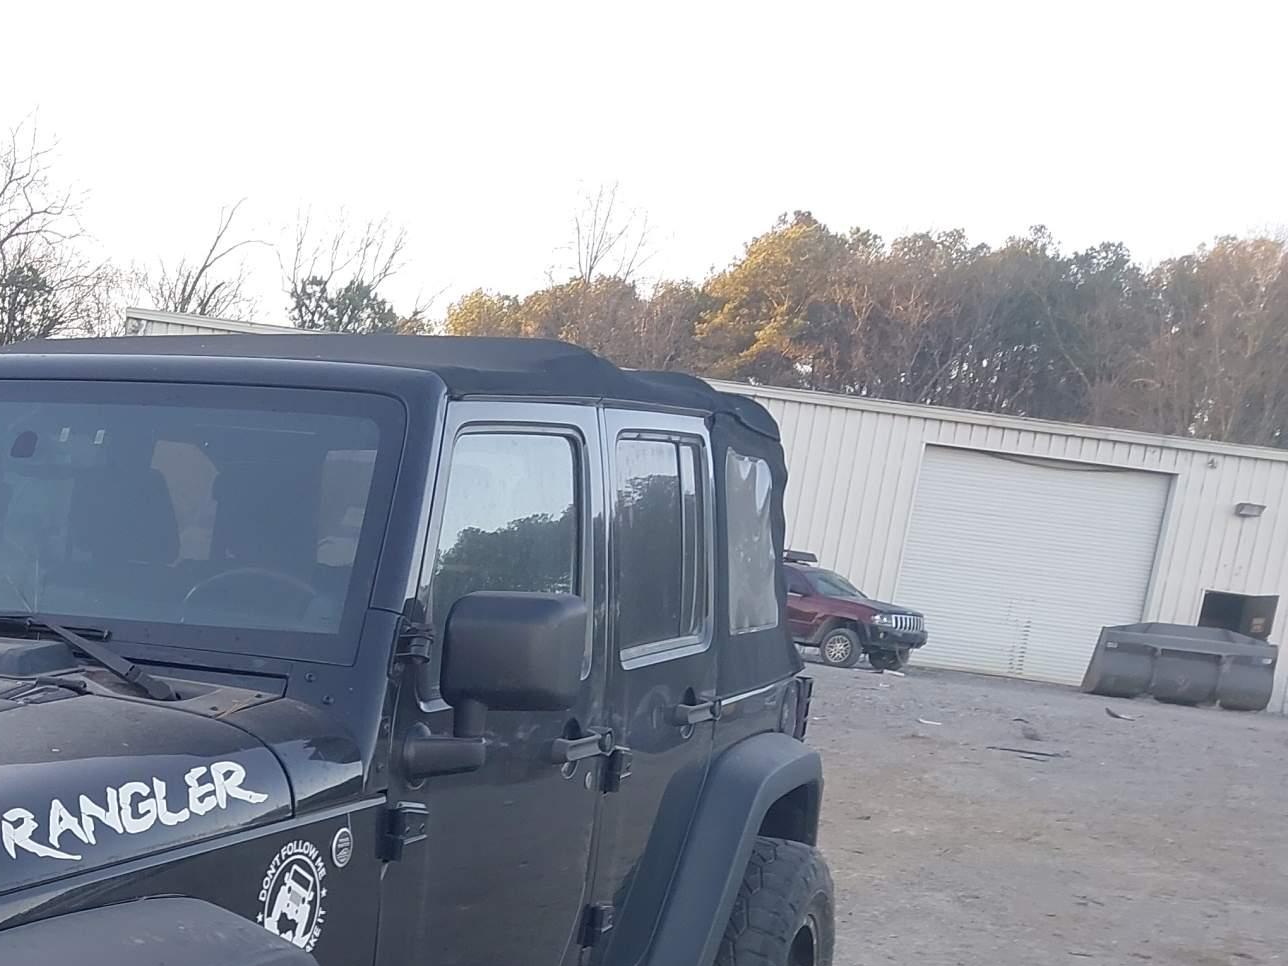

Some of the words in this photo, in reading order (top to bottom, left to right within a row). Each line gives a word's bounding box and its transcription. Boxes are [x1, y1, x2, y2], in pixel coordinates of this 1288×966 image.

[258, 853, 281, 901] DON'T
[281, 840, 319, 860] FOLLOW
[315, 856, 327, 880] ME
[305, 925, 321, 953] AKE
